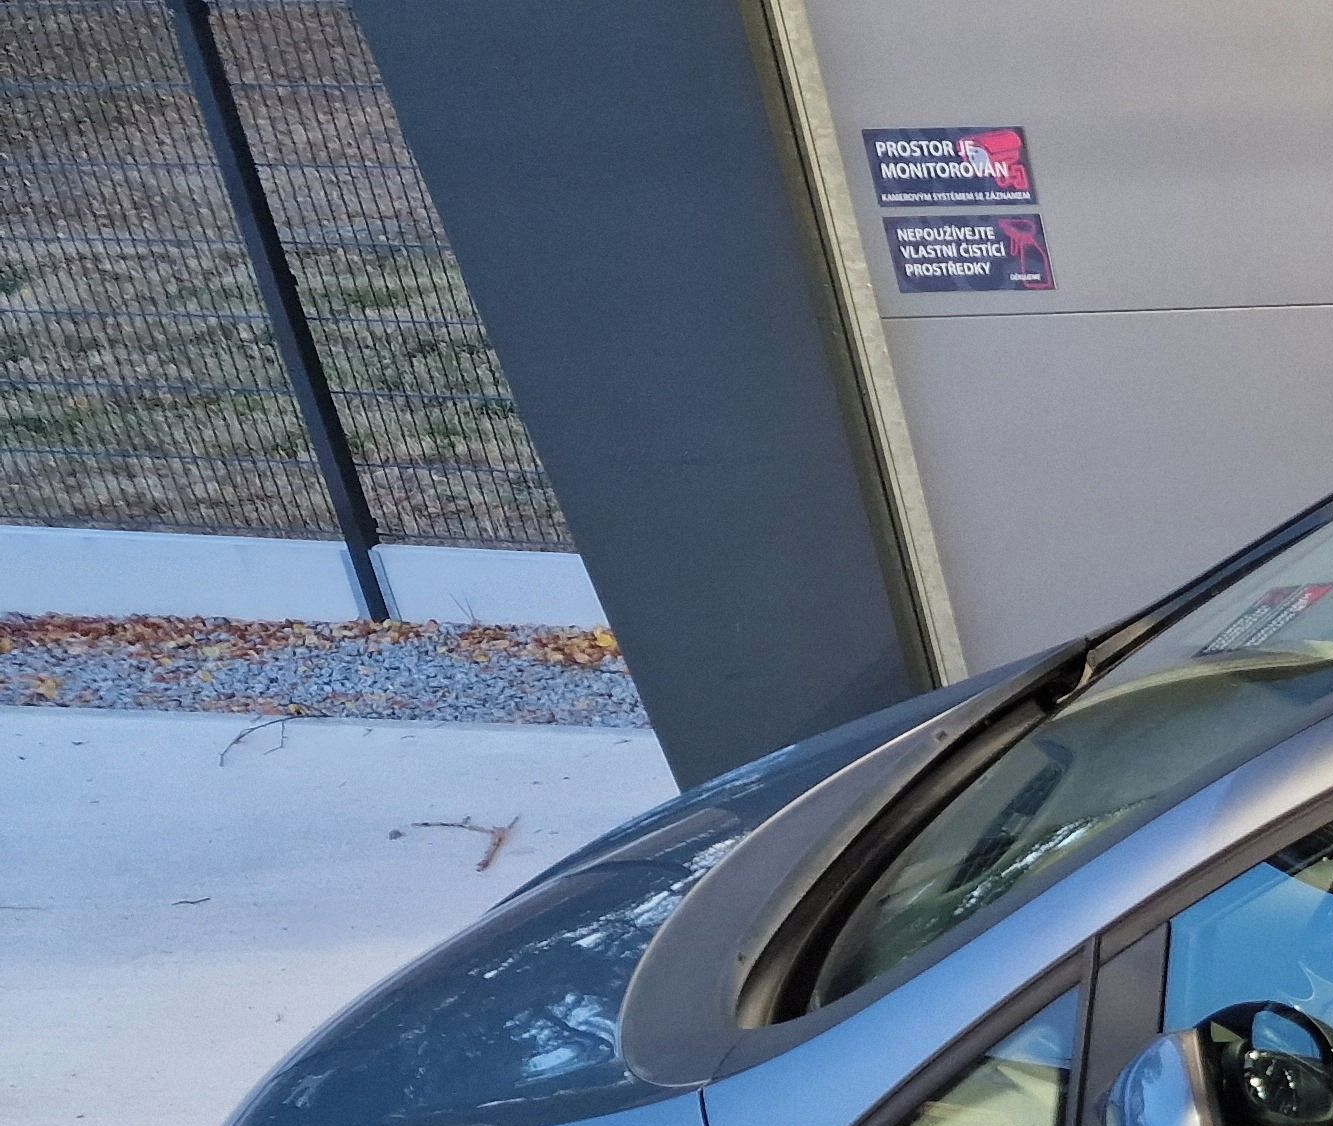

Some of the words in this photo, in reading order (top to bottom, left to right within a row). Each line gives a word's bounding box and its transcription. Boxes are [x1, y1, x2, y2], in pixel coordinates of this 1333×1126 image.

[875, 140, 955, 157] PROSTOR
[958, 140, 976, 156] JE
[897, 225, 996, 241] NEPOUŽÍVEJTE
[900, 243, 958, 258] VLASTNÍ
[960, 241, 1006, 257] ČISTÍCÍ
[905, 261, 990, 277] PROSTŘEDKY
